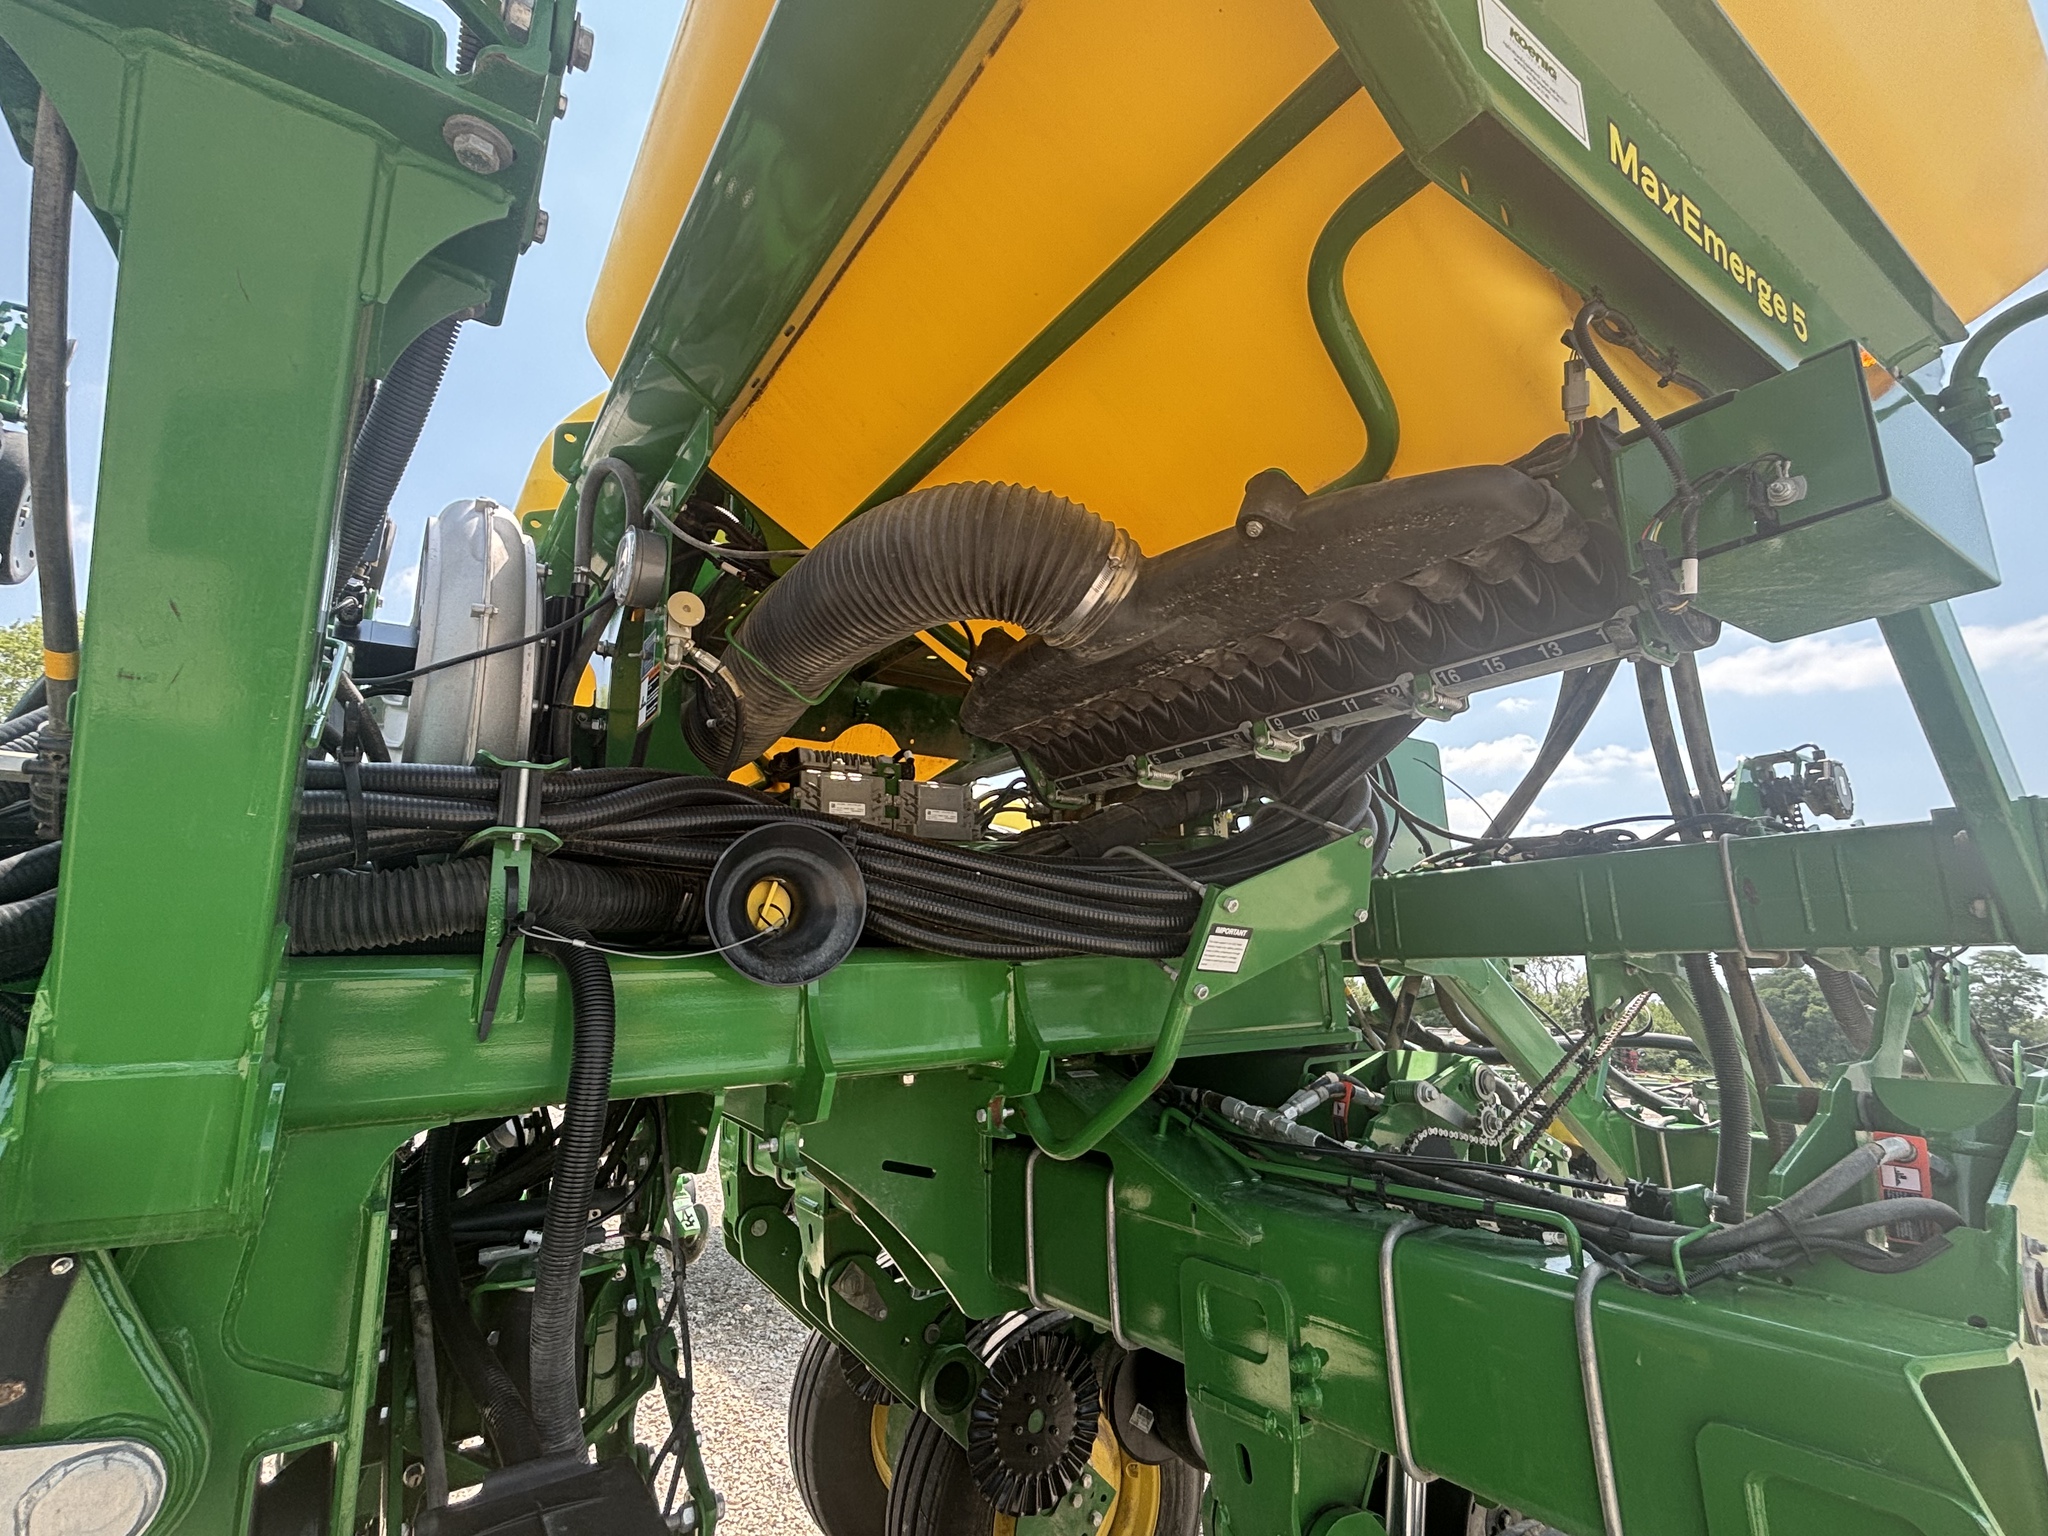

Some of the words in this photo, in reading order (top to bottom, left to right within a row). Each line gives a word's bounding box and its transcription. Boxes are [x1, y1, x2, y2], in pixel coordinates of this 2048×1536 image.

[1607, 121, 1788, 326] MaxEmerge
[1792, 302, 1810, 343] 5
[1438, 669, 1462, 686] 16
[1482, 657, 1507, 674] 15
[1537, 641, 1564, 659] 13
[1273, 717, 1285, 730] 9
[1301, 708, 1321, 723] 10
[1341, 697, 1360, 713] 11
[1174, 748, 1185, 759] 6
[1202, 740, 1212, 752] 7
[1214, 926, 1248, 936] IMPORTANT
